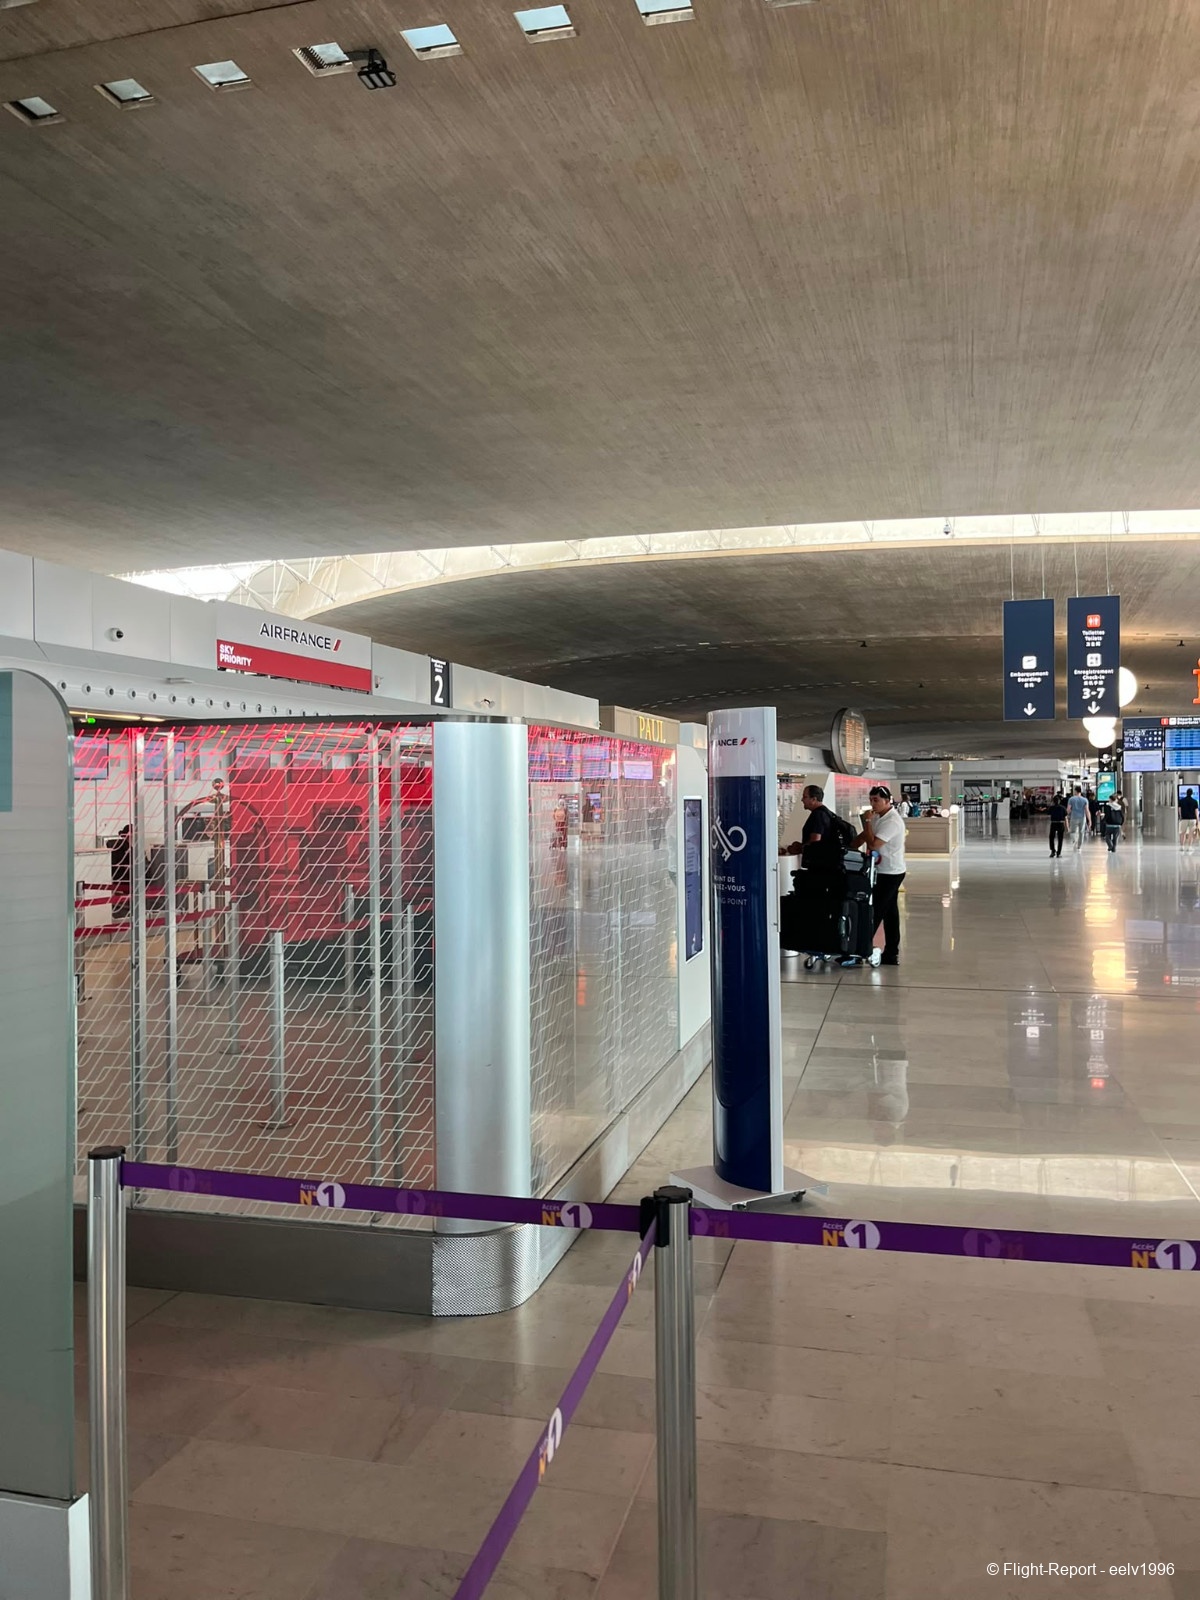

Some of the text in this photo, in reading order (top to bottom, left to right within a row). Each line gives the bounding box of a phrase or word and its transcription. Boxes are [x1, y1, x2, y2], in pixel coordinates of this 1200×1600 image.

[260, 623, 331, 650] AIRFRANCE
[219, 644, 234, 655] SKY
[219, 653, 252, 667] PRIORITY
[434, 675, 444, 704] 2
[1082, 687, 1105, 699] 3-7
[638, 715, 666, 744] PAUL
